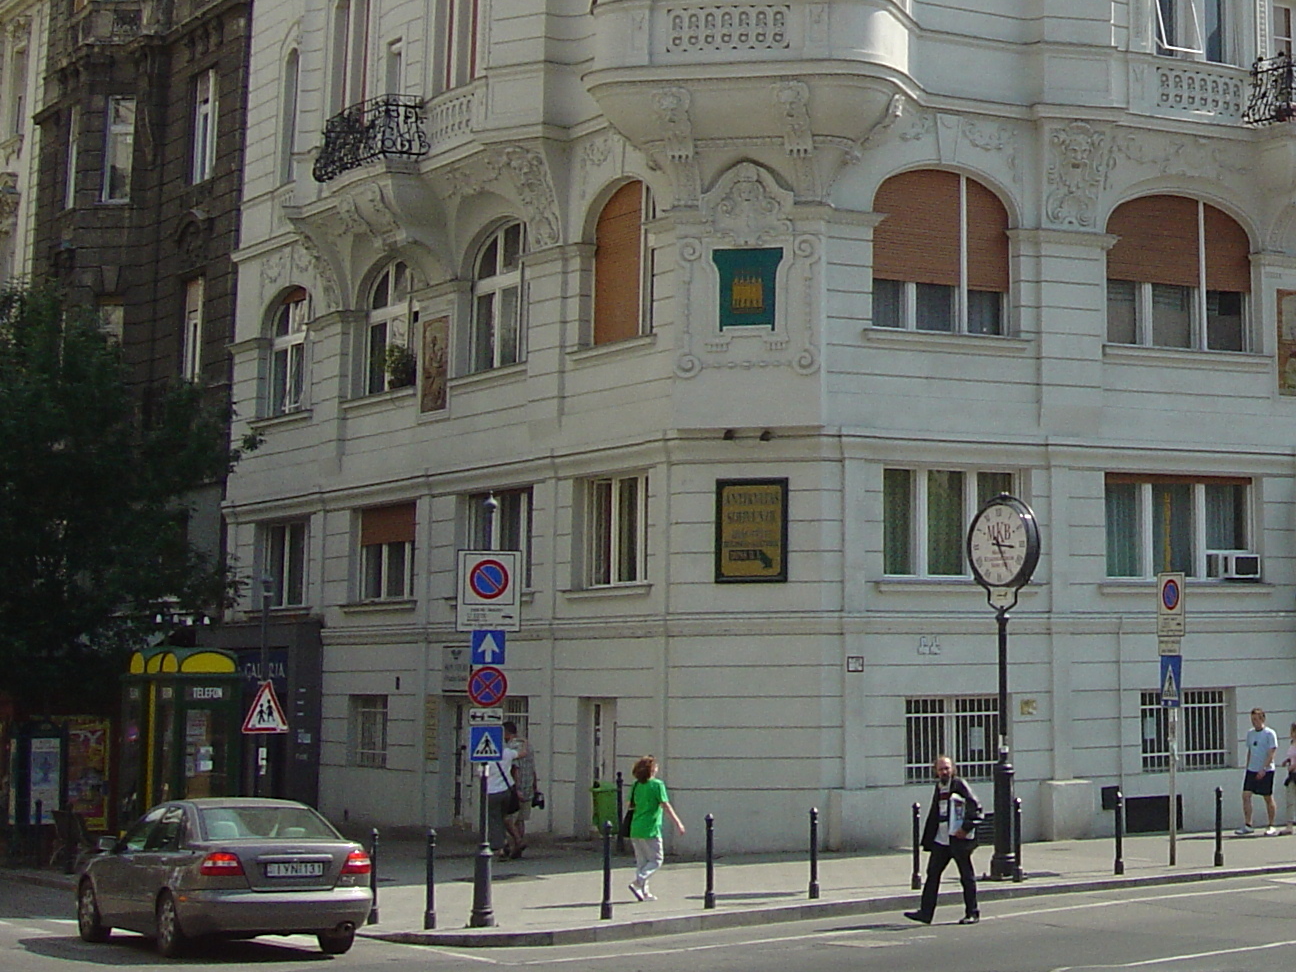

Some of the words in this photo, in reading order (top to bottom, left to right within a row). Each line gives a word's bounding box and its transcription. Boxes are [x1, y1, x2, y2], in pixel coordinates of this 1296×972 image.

[987, 522, 1011, 543] MKB
[245, 662, 286, 679] GALRIA
[193, 687, 222, 699] TELEFON
